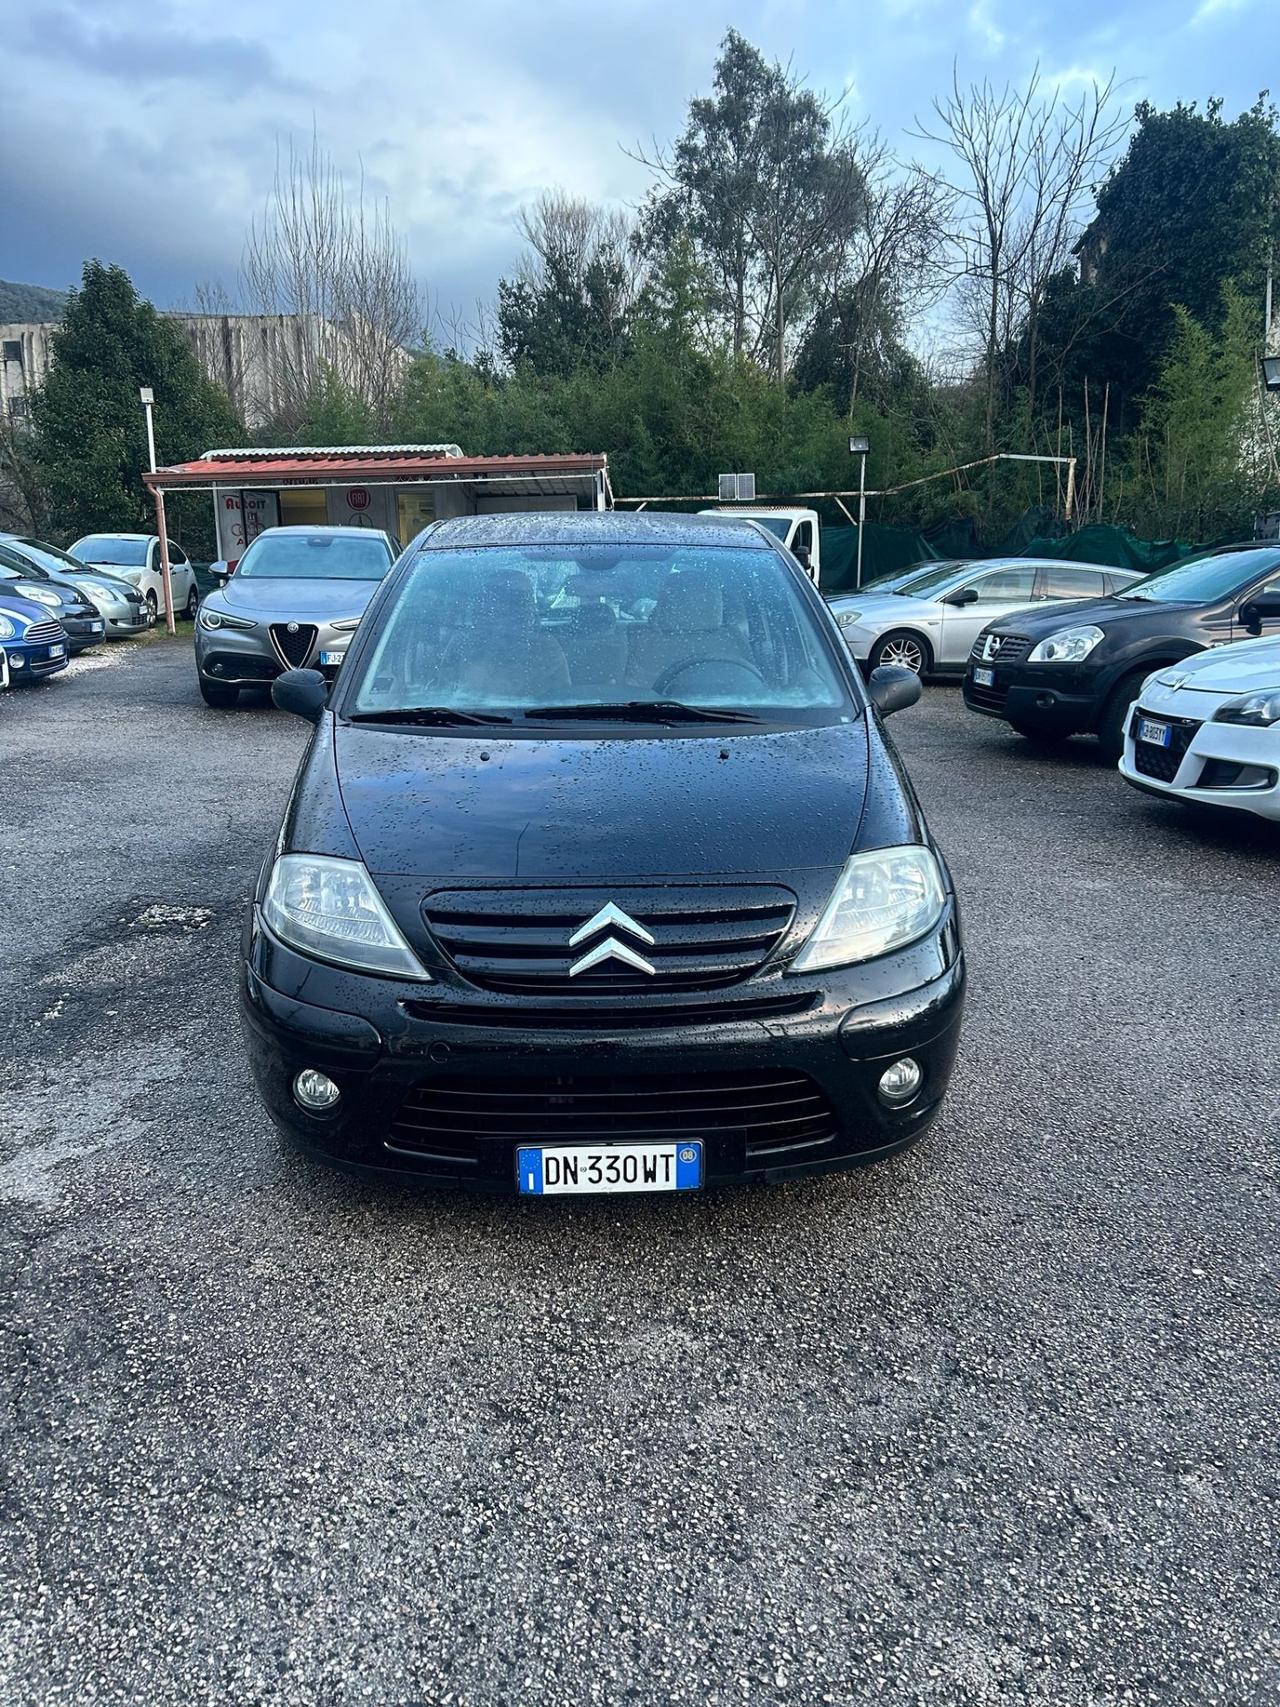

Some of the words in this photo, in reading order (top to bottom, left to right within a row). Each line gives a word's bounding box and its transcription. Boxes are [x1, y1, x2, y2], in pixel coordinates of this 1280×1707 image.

[682, 1151, 693, 1161] 08
[545, 1155, 579, 1186] DN
[587, 1153, 675, 1185] 330WT
